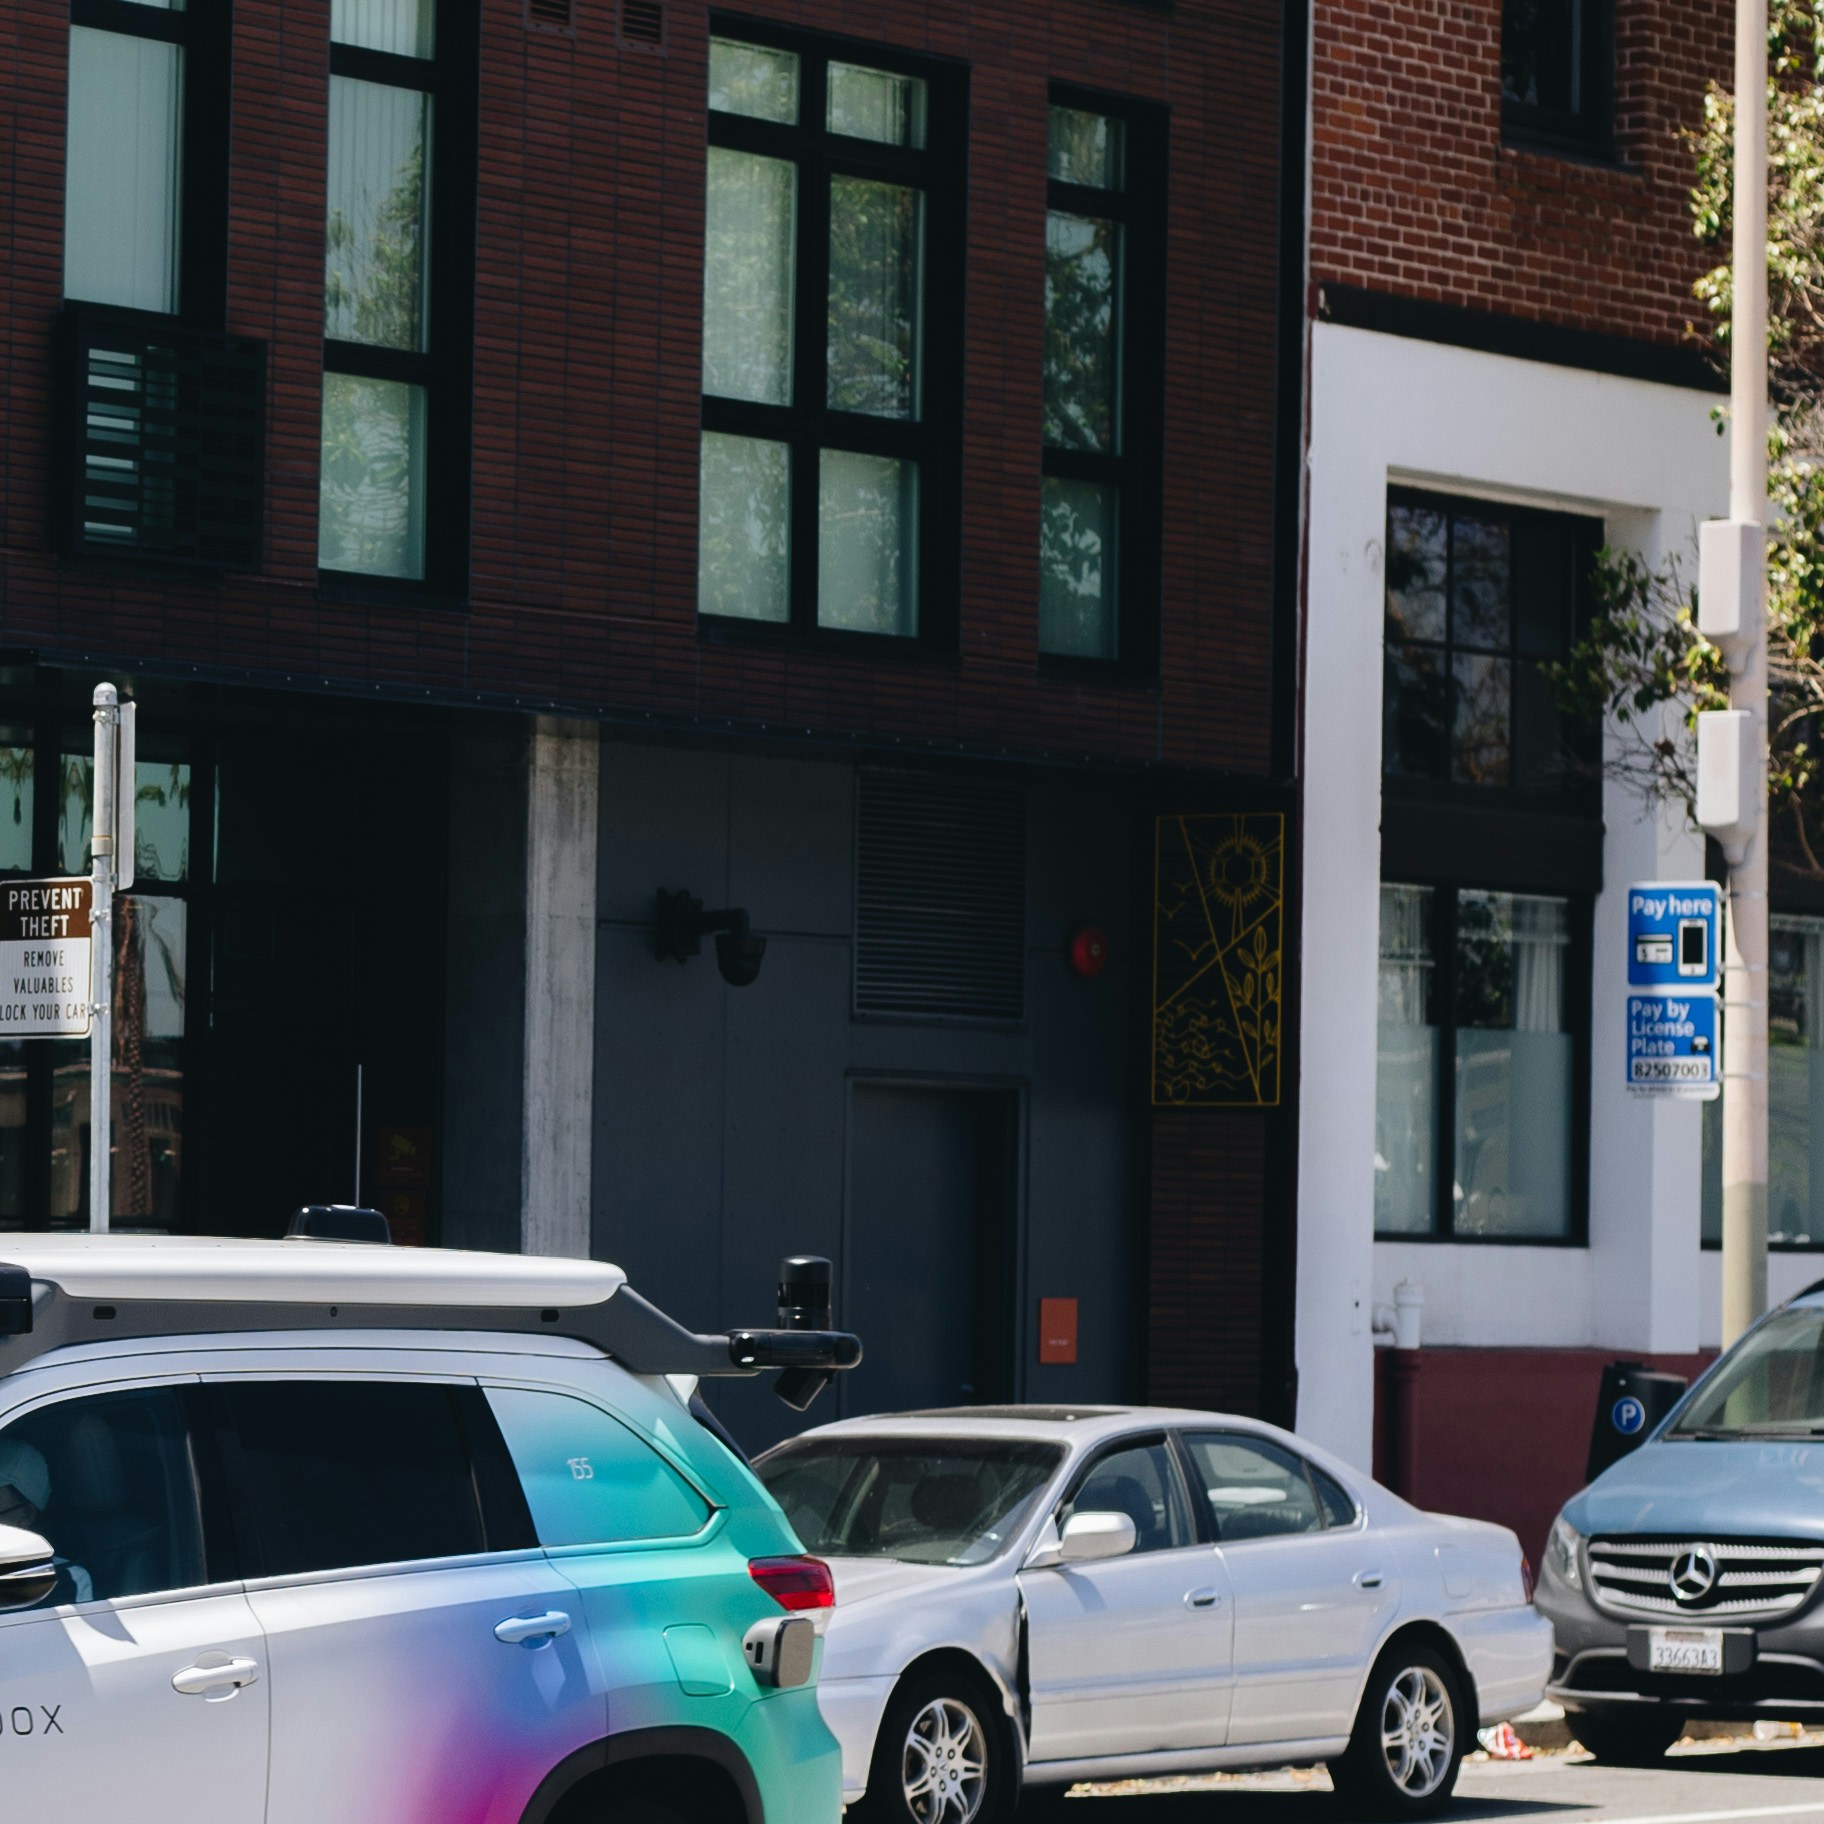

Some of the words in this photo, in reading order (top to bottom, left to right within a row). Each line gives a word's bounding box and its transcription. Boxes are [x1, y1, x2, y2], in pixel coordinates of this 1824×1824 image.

[9, 887, 82, 911] PREVENT
[1632, 896, 1666, 920] Pay
[1669, 894, 1712, 916] here
[20, 914, 69, 937] THEFT
[24, 950, 64, 967] REMOVE
[14, 977, 73, 994] VALUABLES
[0, 1004, 26, 1021] LOCK
[32, 1003, 59, 1020] YOUR
[65, 1002, 86, 1020] CAR
[1631, 1000, 1663, 1020] Pay
[1666, 998, 1690, 1021] by
[1632, 1021, 1695, 1037] License
[1632, 1038, 1675, 1056] Plate
[1634, 1062, 1709, 1078] 82507003
[1622, 1404, 1636, 1426] P
